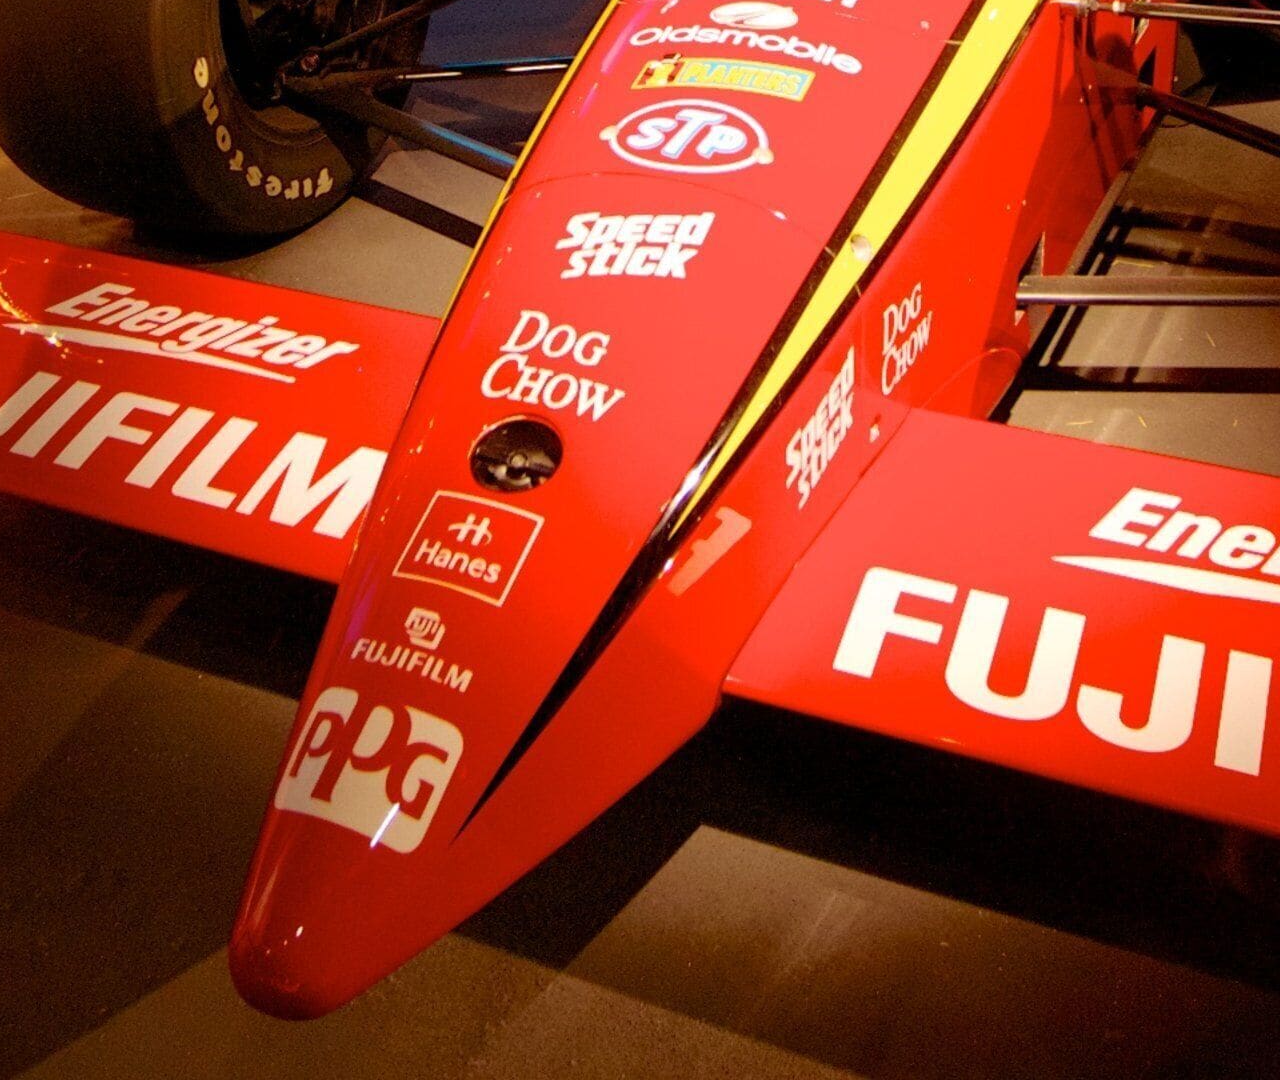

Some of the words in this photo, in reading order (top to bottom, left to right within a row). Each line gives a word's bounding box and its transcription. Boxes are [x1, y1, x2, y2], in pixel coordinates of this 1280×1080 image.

[630, 25, 863, 74] Oldsmobile
[682, 62, 802, 96] PLANTERS
[193, 56, 334, 202] Firestone
[626, 109, 748, 159] STP
[44, 282, 359, 372] Energizer
[500, 310, 611, 366] DOG
[882, 283, 922, 356] DOG
[881, 311, 932, 396] CHOW
[481, 352, 625, 422] CHOW
[415, 540, 502, 585] Hanes
[351, 637, 473, 694] FUJIFILM
[290, 704, 450, 820] PPG
